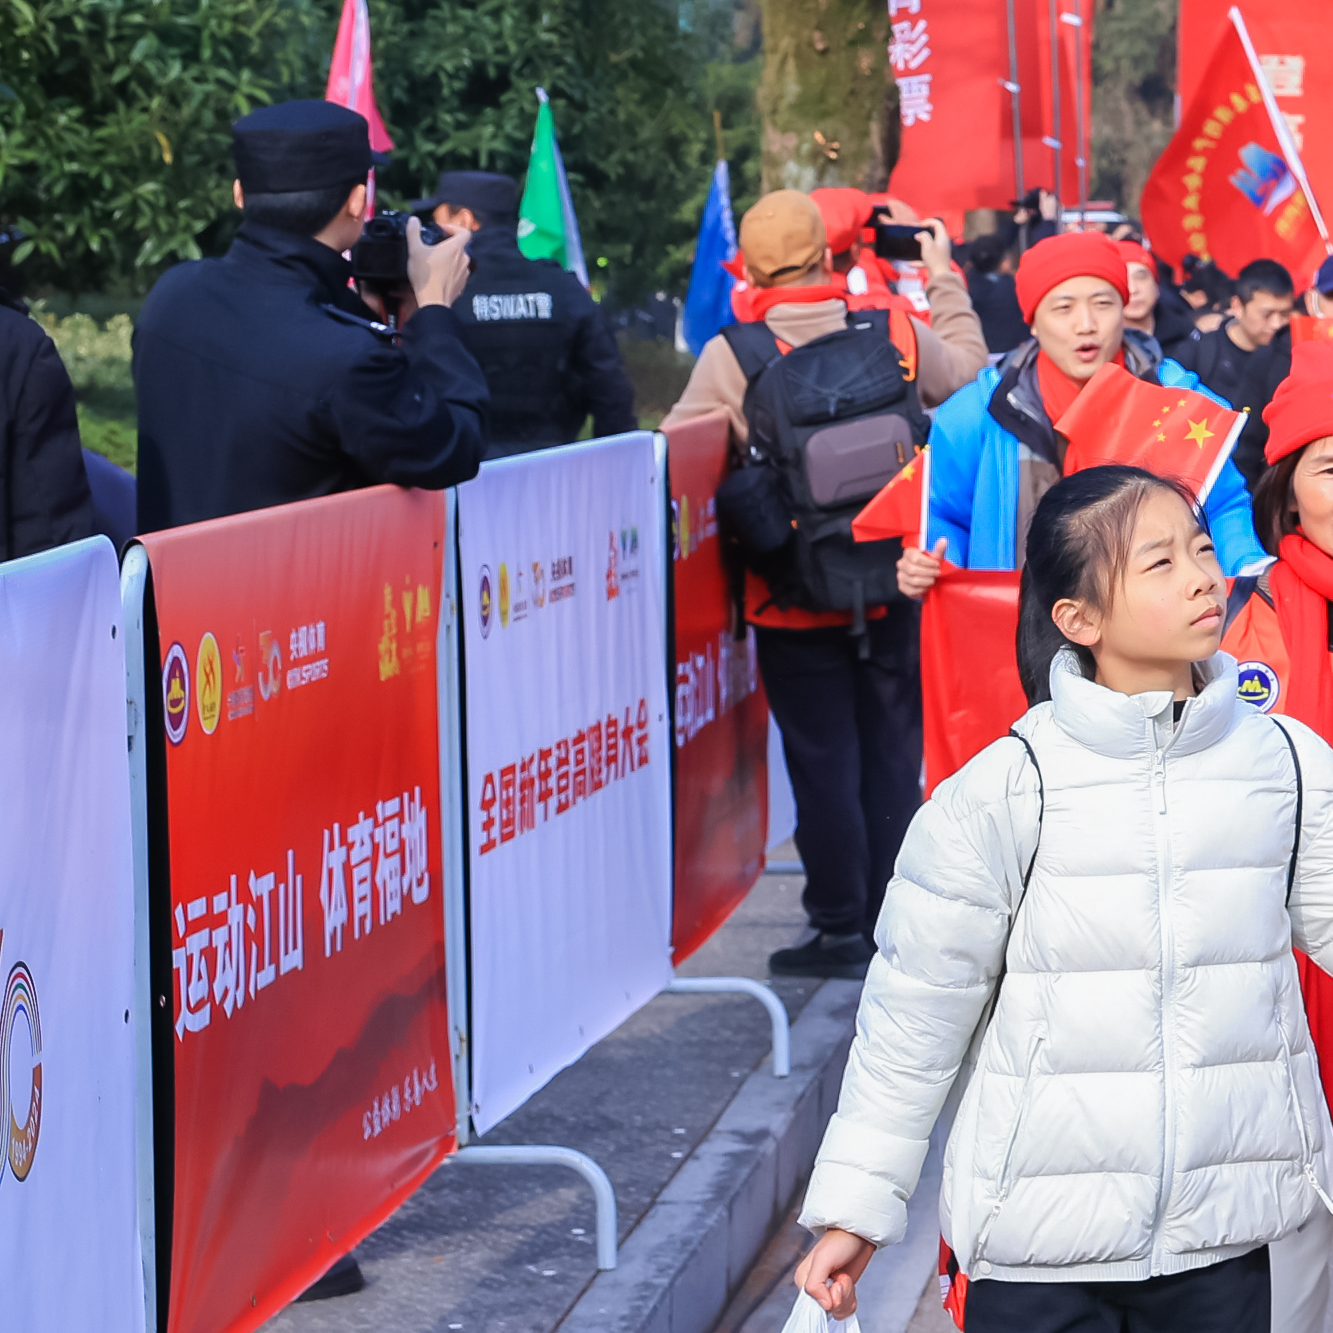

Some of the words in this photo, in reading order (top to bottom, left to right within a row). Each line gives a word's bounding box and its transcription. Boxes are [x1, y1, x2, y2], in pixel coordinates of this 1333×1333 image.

[479, 697, 649, 856] 全国新年登高健身大会
[172, 849, 304, 1042] 运动江山
[319, 786, 430, 958] 体育福地
